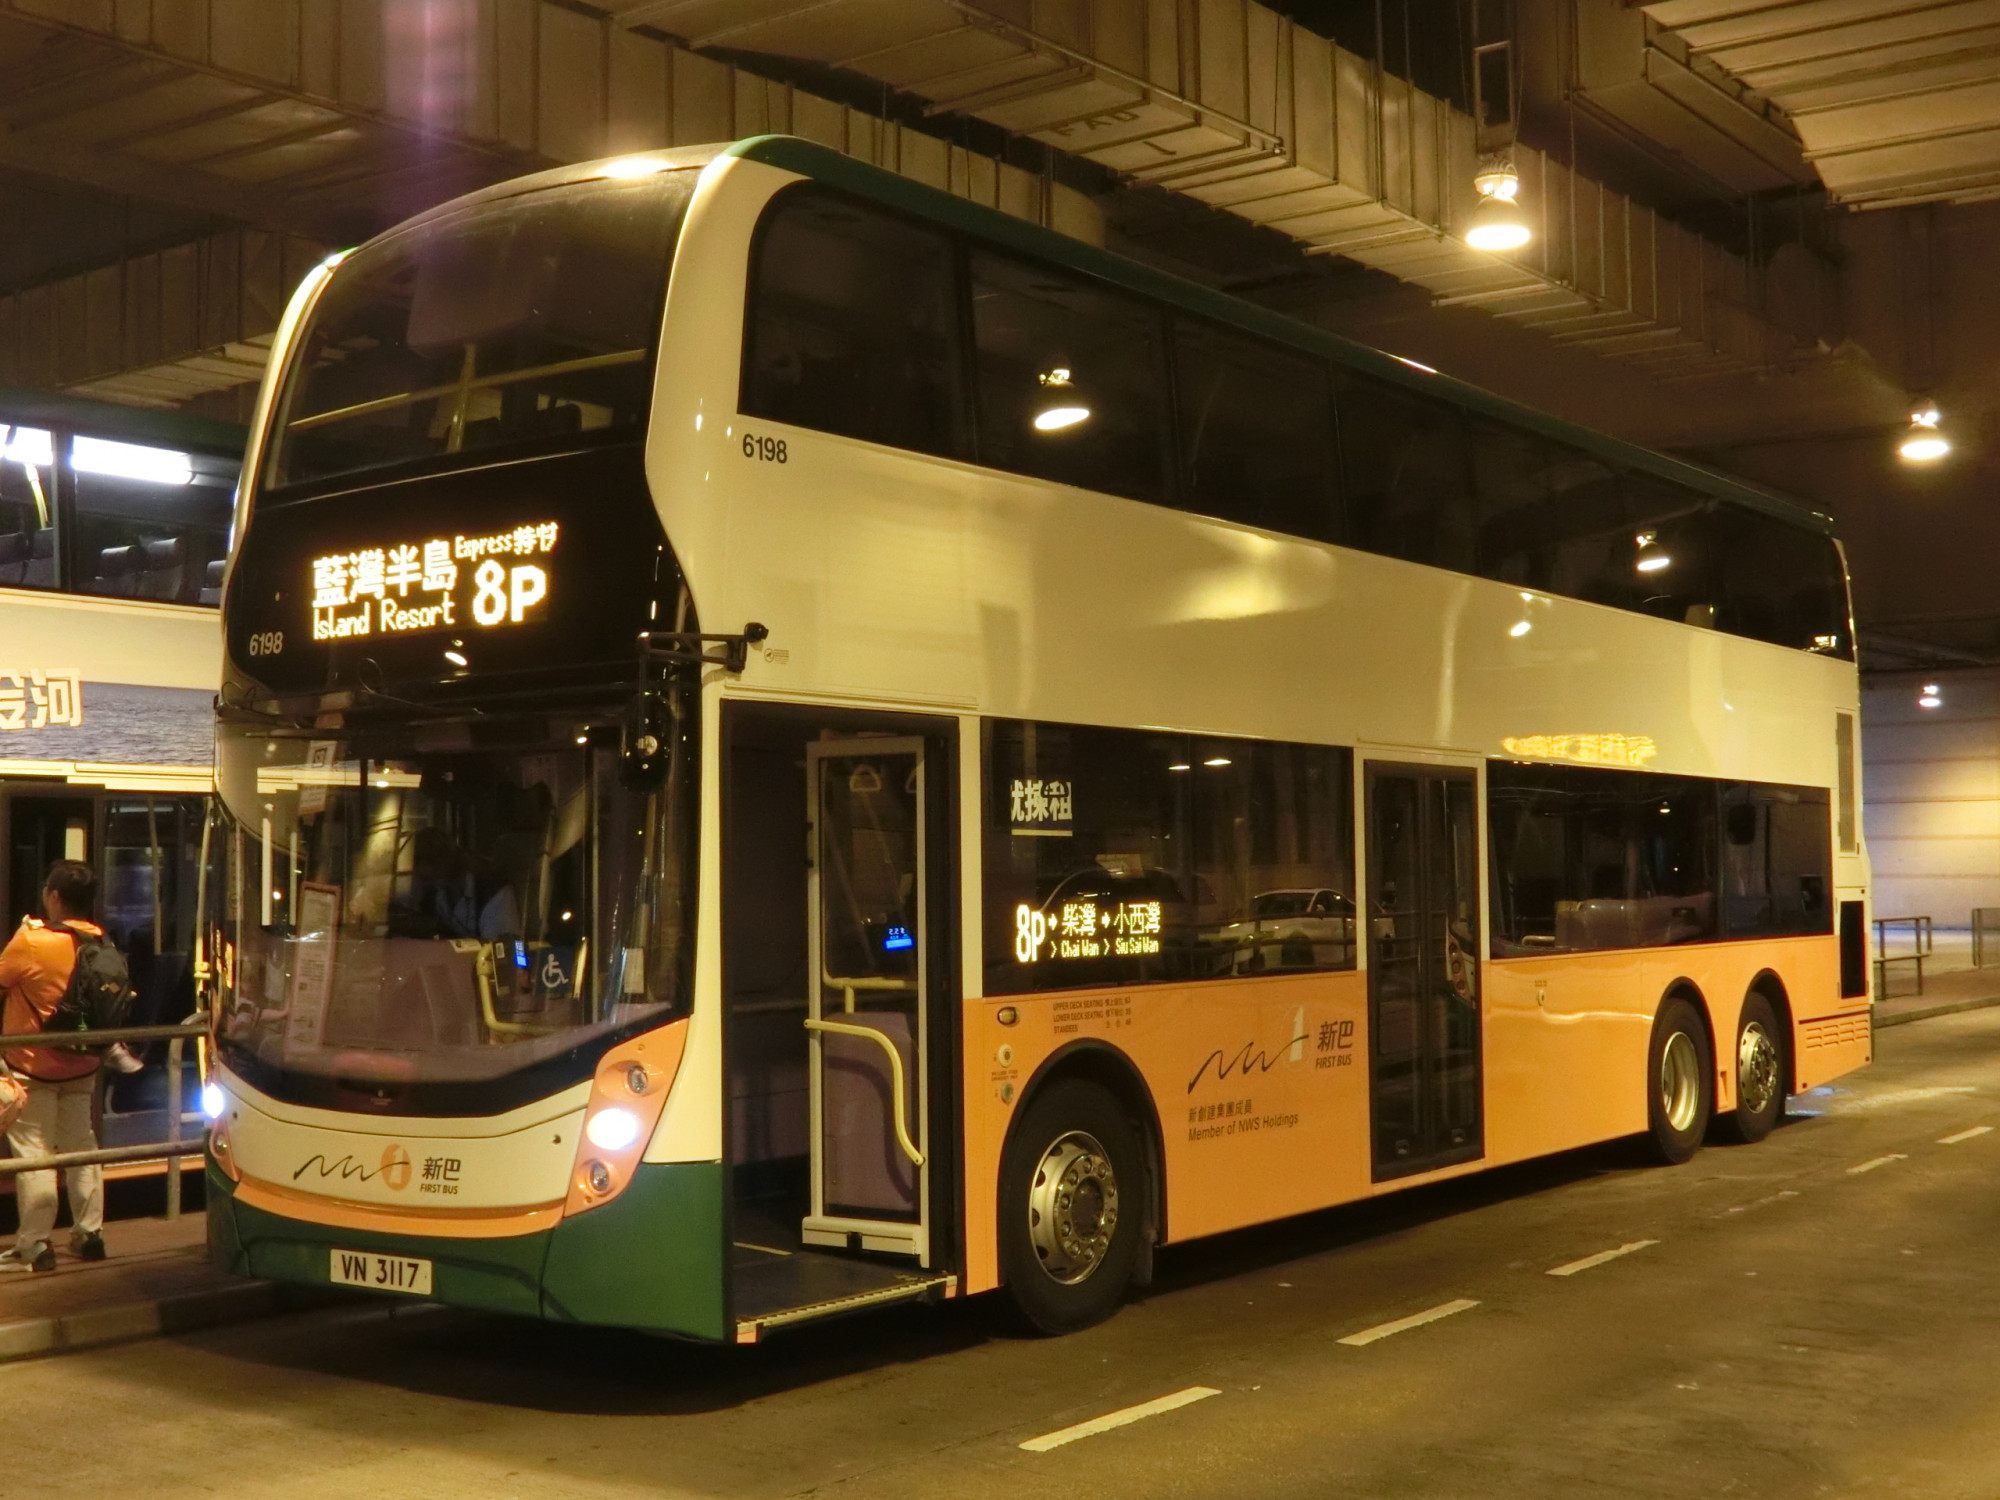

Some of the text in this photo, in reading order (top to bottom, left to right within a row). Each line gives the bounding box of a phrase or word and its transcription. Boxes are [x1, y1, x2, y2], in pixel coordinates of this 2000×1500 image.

[743, 433, 788, 464] 6198
[455, 534, 513, 562] Express
[312, 539, 458, 607] 藍灣半島
[472, 559, 547, 626] 8P
[312, 591, 456, 640] Island Resort
[249, 631, 284, 656] 6198
[1016, 904, 1046, 962] 8P
[1062, 901, 1161, 937] 柴灣 小西灣
[1061, 936, 1159, 958] Chai Wan Siu Sai Wan
[1317, 1020, 1354, 1052] 新巴
[1315, 1054, 1352, 1069] FIRST BUS
[1188, 1114, 1299, 1142] Member of NWS Holdings
[421, 1156, 462, 1182] 新巴
[420, 1183, 459, 1195] FIRST BUS
[341, 1254, 420, 1289] VN 3117
